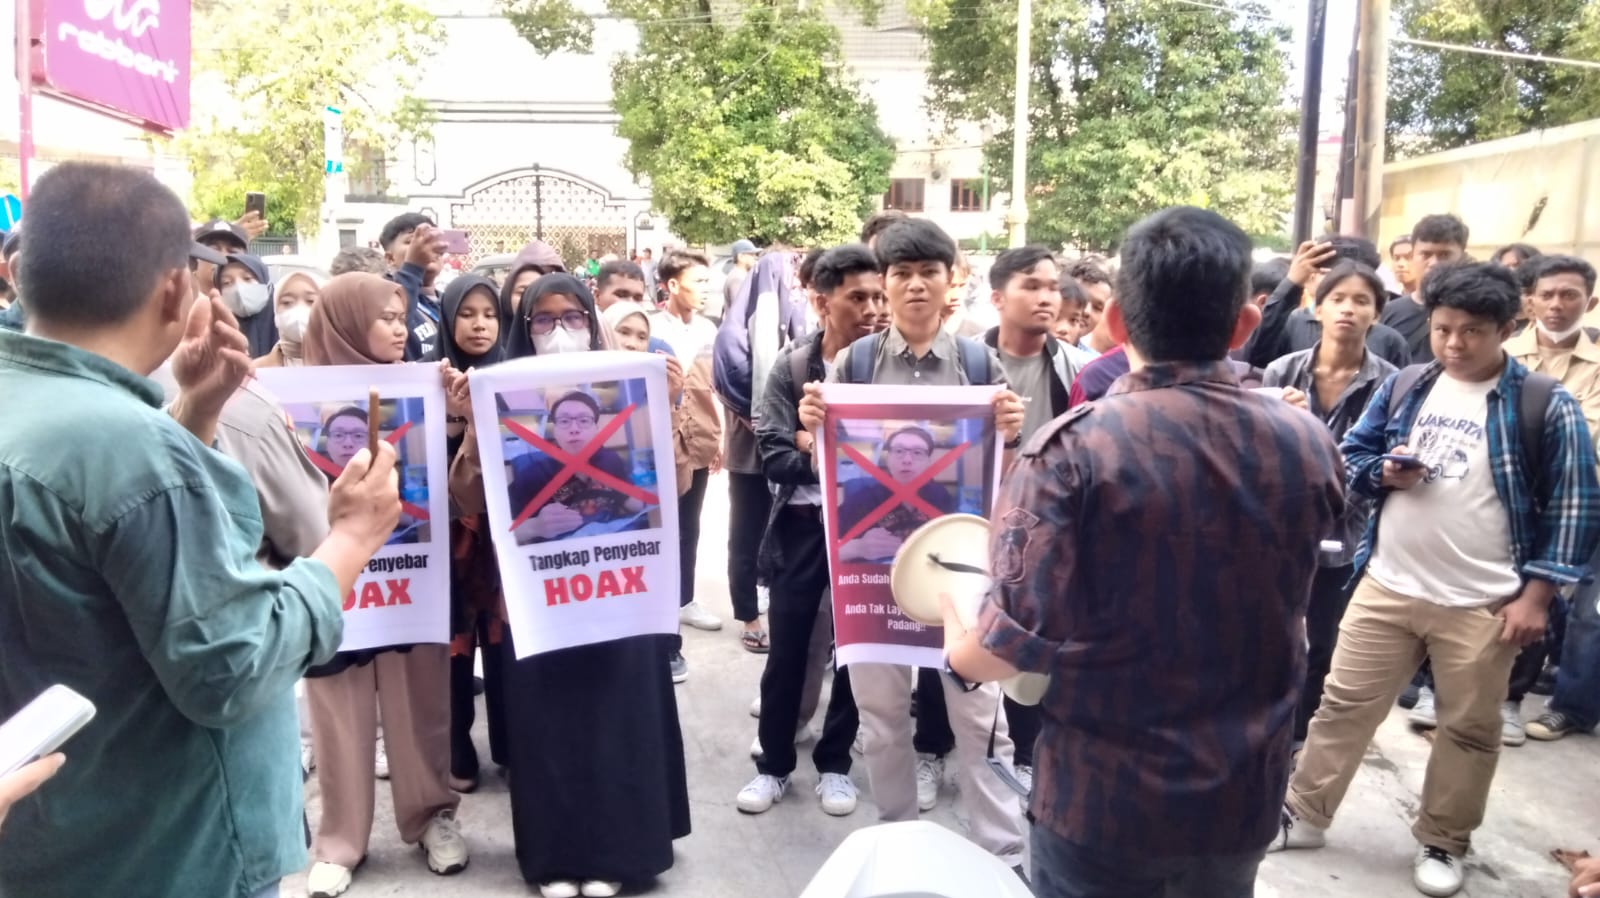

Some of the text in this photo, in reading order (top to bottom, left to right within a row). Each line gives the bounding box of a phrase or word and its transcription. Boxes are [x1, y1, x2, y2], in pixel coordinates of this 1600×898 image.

[1417, 413, 1483, 440] JAKARTA
[361, 553, 429, 573] enyebar
[528, 540, 661, 571] Tangkap Penyebar
[543, 565, 648, 607] HOAX
[838, 573, 890, 586] Anda Sudah
[845, 603, 867, 615] Anda
[868, 603, 885, 615] Tak
